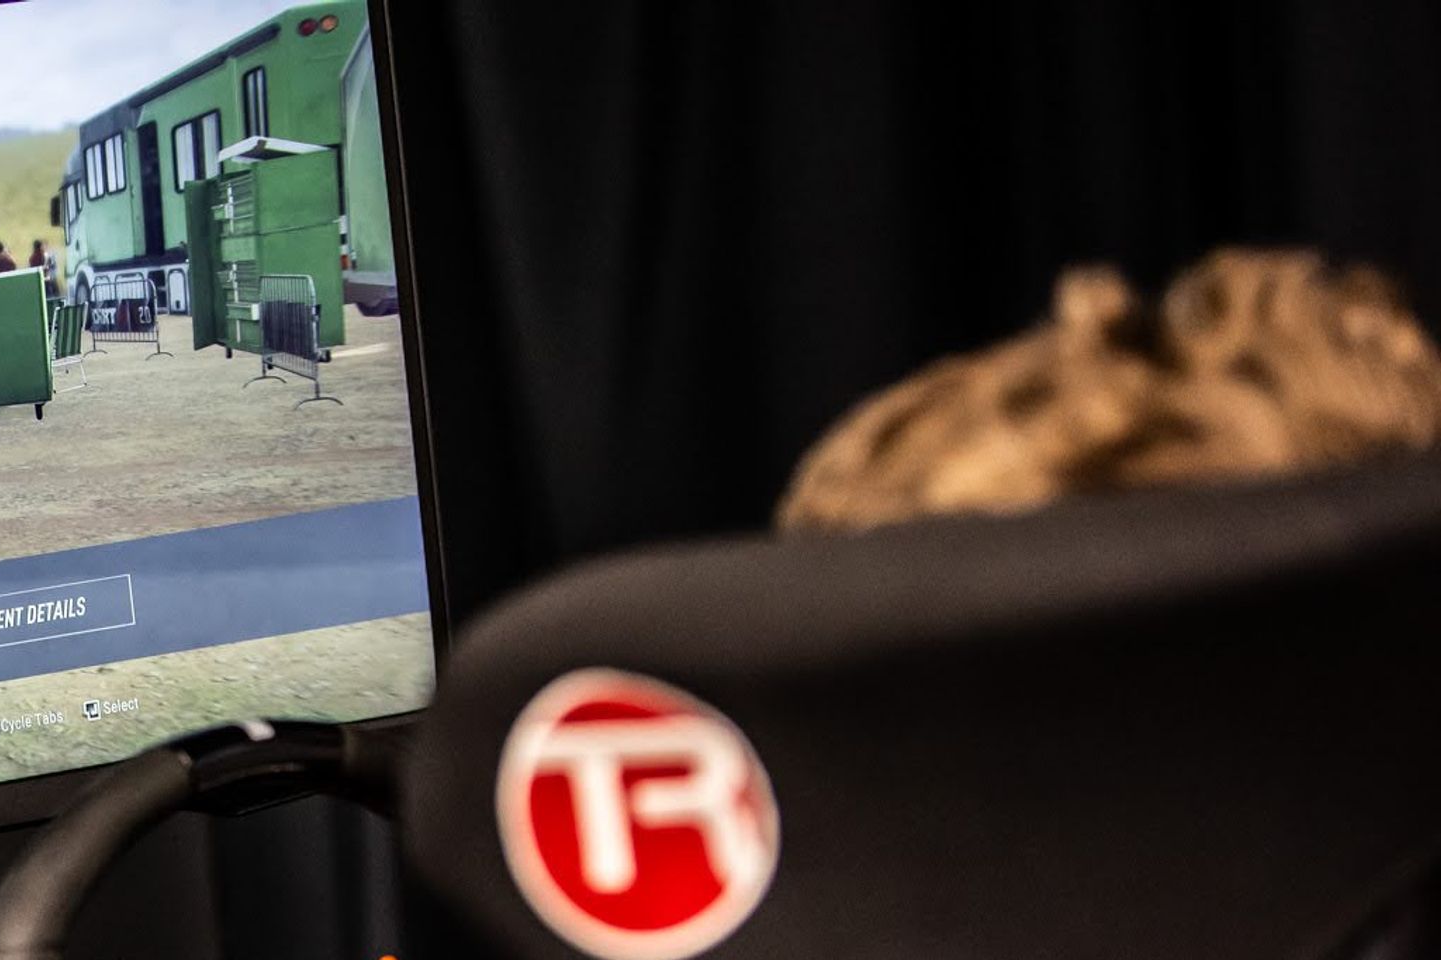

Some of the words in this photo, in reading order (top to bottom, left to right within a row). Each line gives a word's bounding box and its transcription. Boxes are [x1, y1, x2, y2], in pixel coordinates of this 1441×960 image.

[27, 596, 87, 625] DETAILS
[102, 697, 139, 715] Select
[1, 715, 32, 734] Cycle
[34, 710, 64, 726] Tabs
